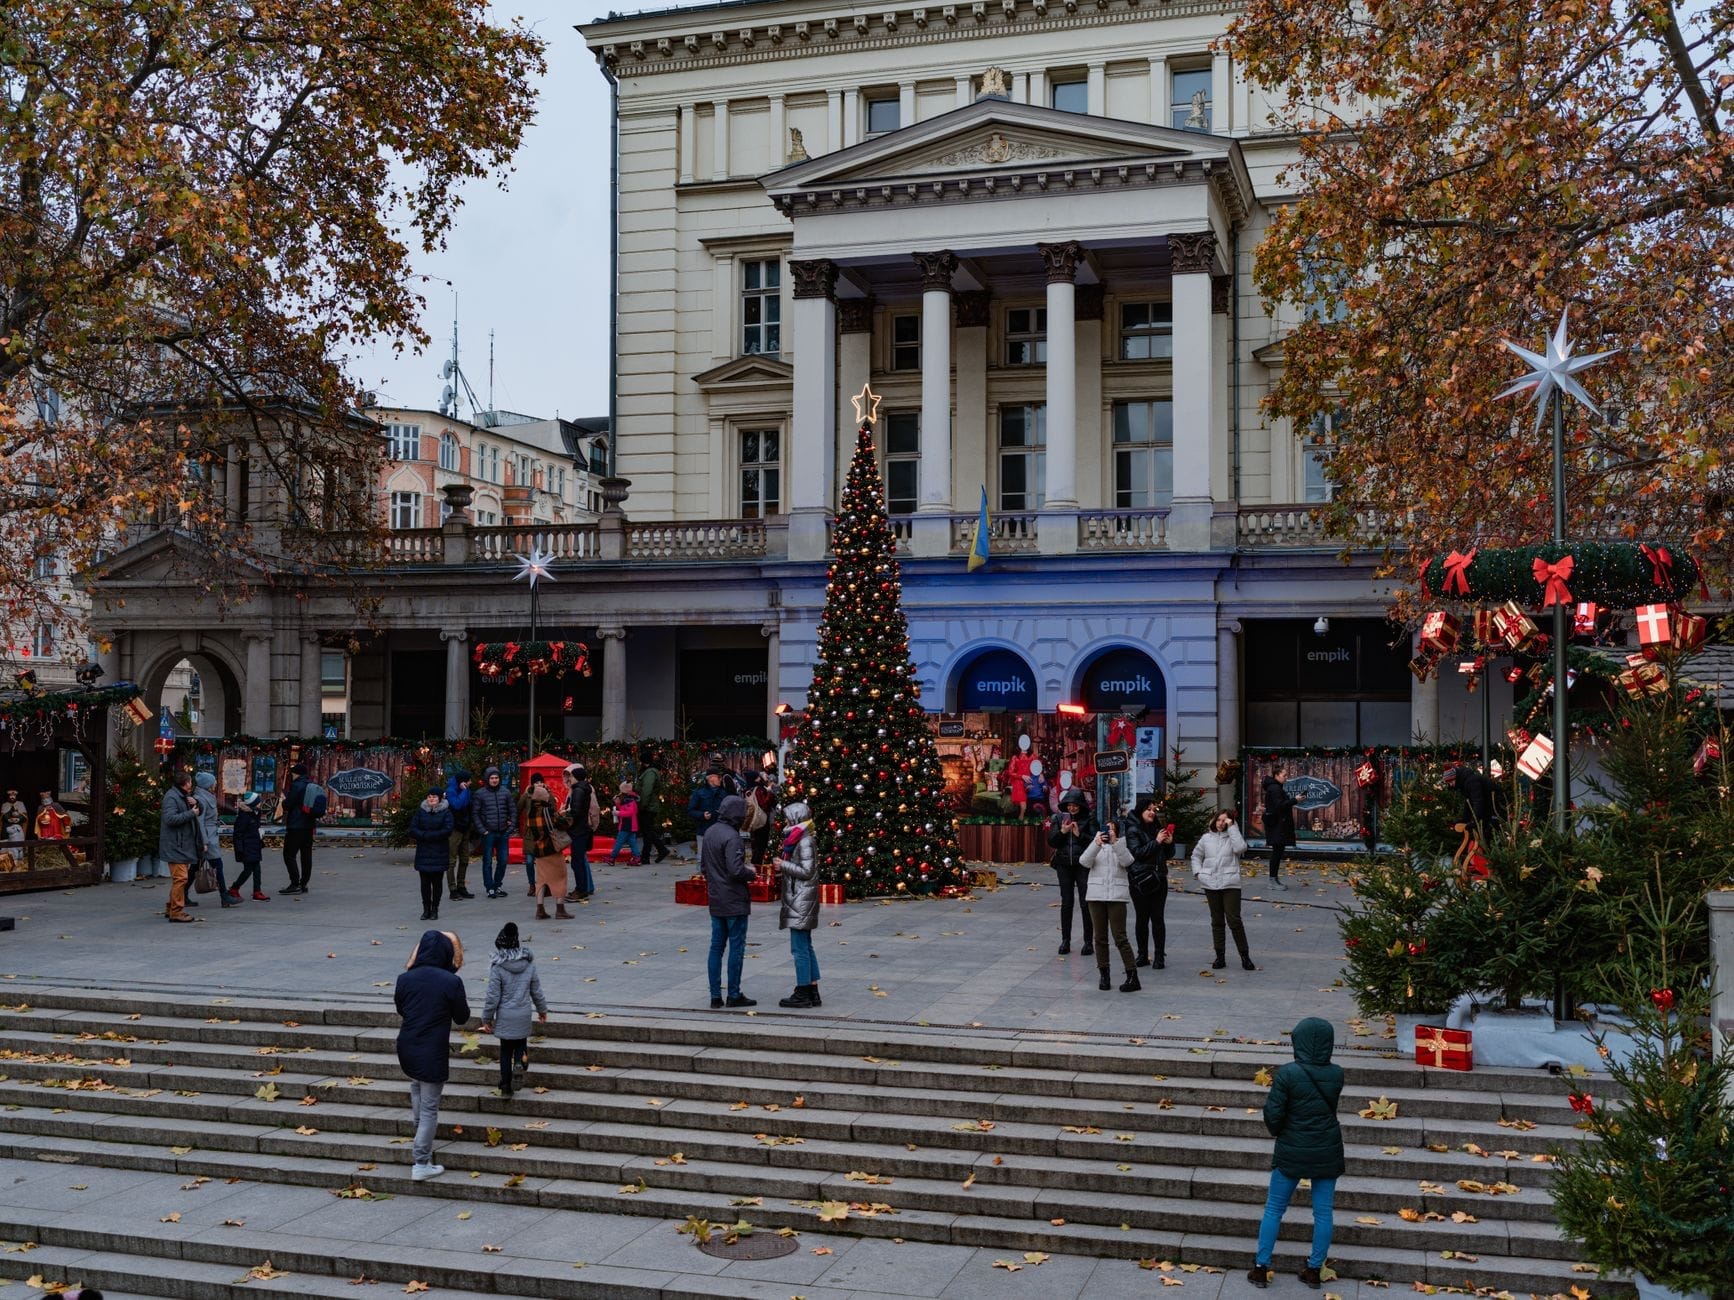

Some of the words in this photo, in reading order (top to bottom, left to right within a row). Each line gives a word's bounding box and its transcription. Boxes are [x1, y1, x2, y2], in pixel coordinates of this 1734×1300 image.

[1306, 647, 1351, 663] empik
[977, 675, 1025, 694] empik
[1100, 674, 1151, 694] empik
